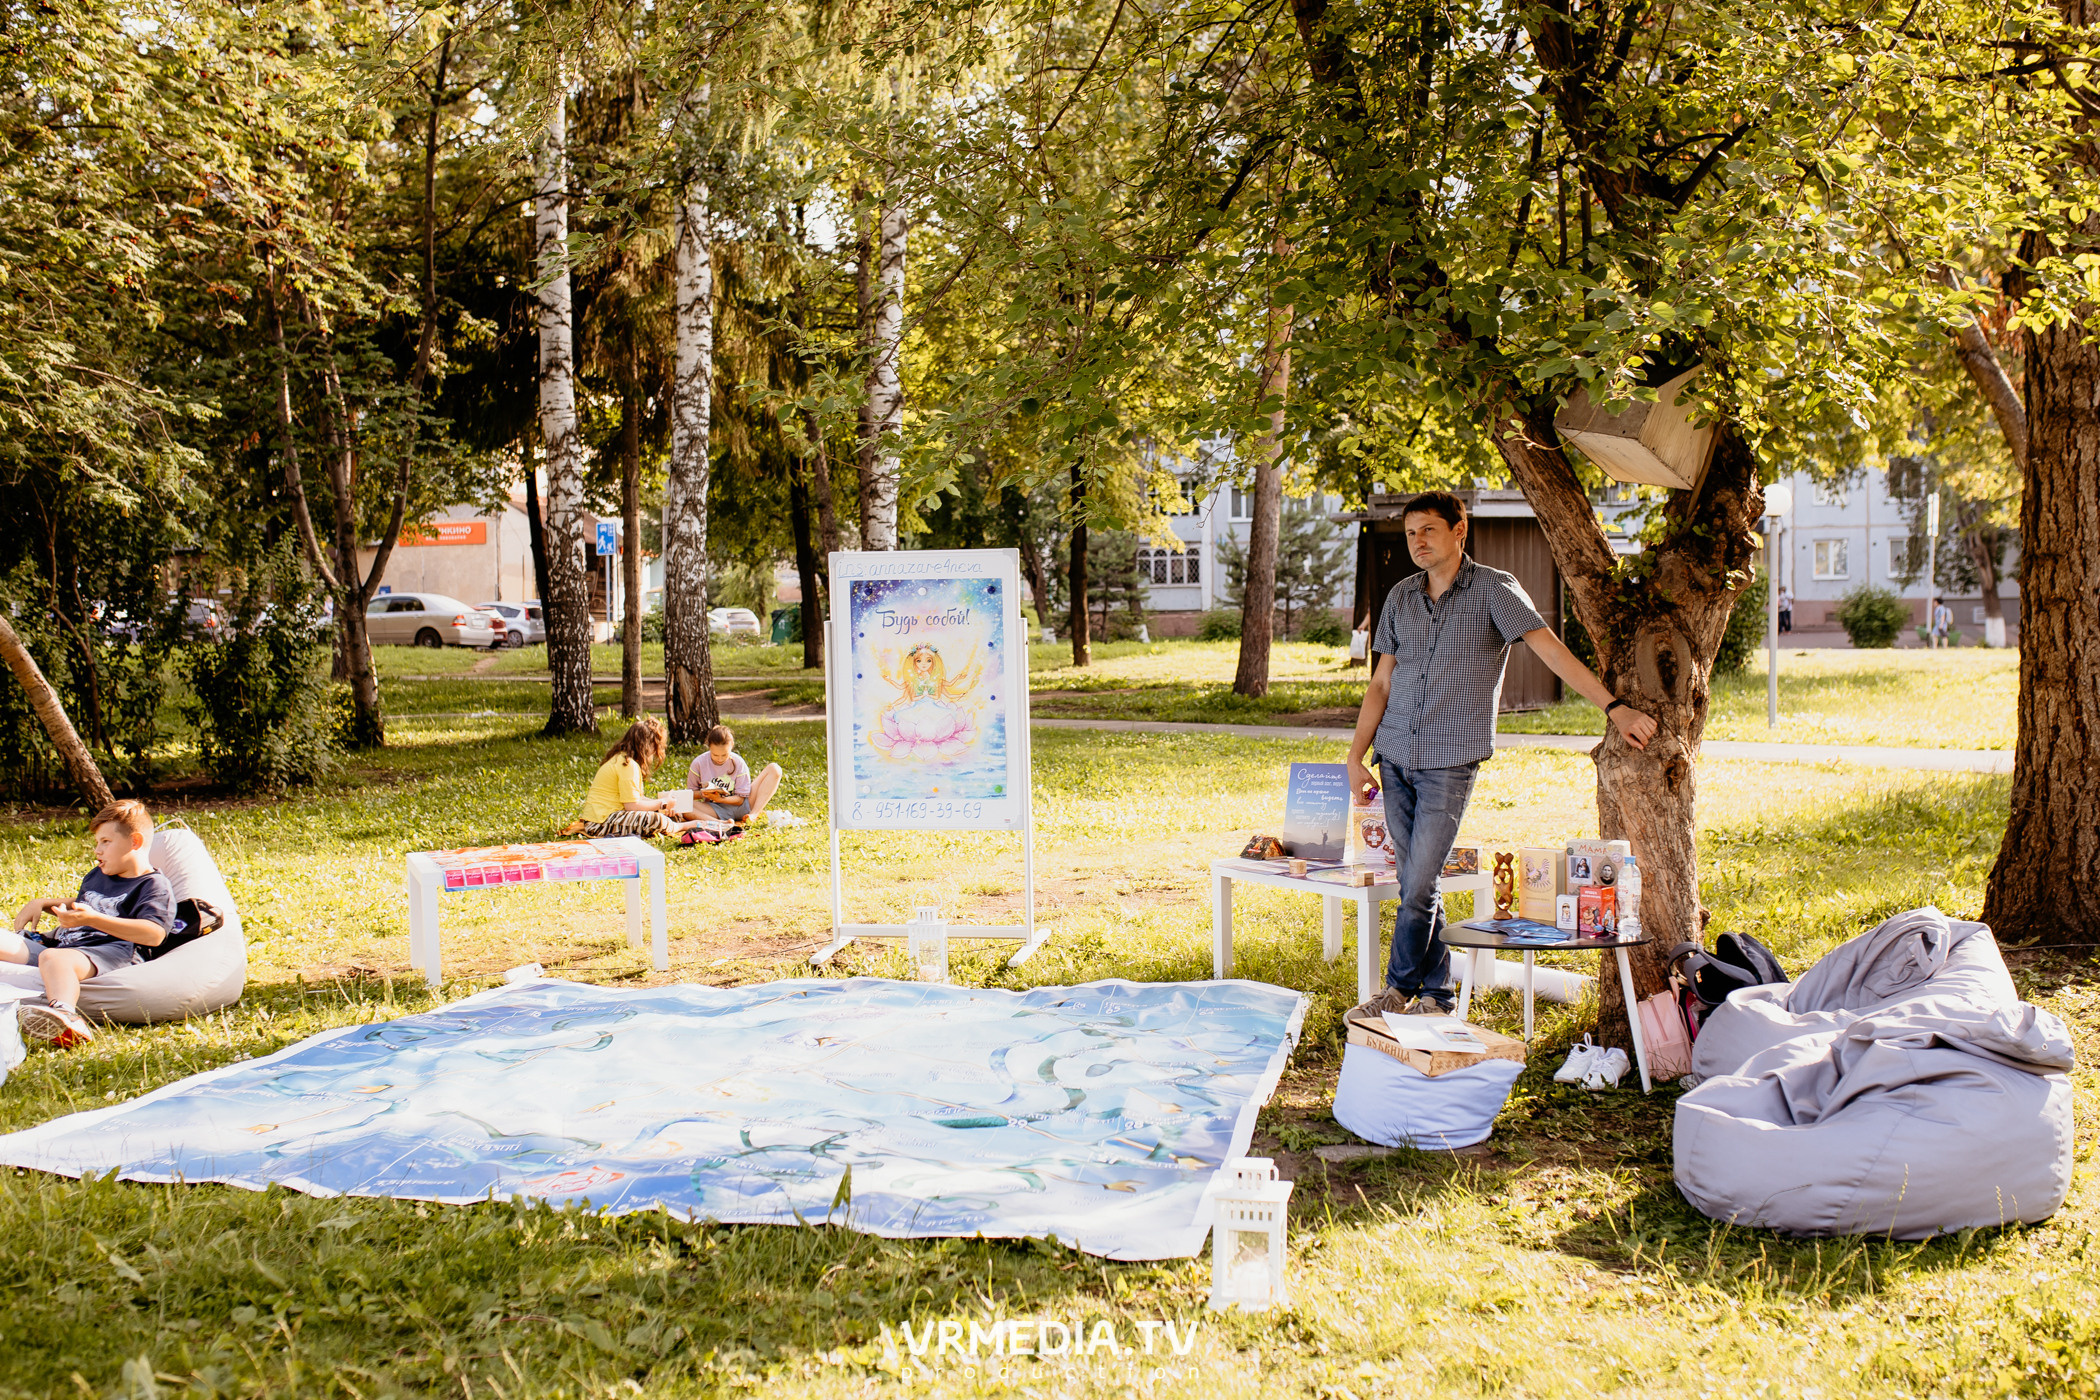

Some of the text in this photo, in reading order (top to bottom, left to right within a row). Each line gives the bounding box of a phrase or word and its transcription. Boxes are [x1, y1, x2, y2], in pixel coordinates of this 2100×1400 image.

[875, 607, 971, 635] Будь собой!
[1297, 768, 1344, 788] Сделайте
[1007, 1118, 1028, 1129] 29
[1124, 1119, 1144, 1131] 28
